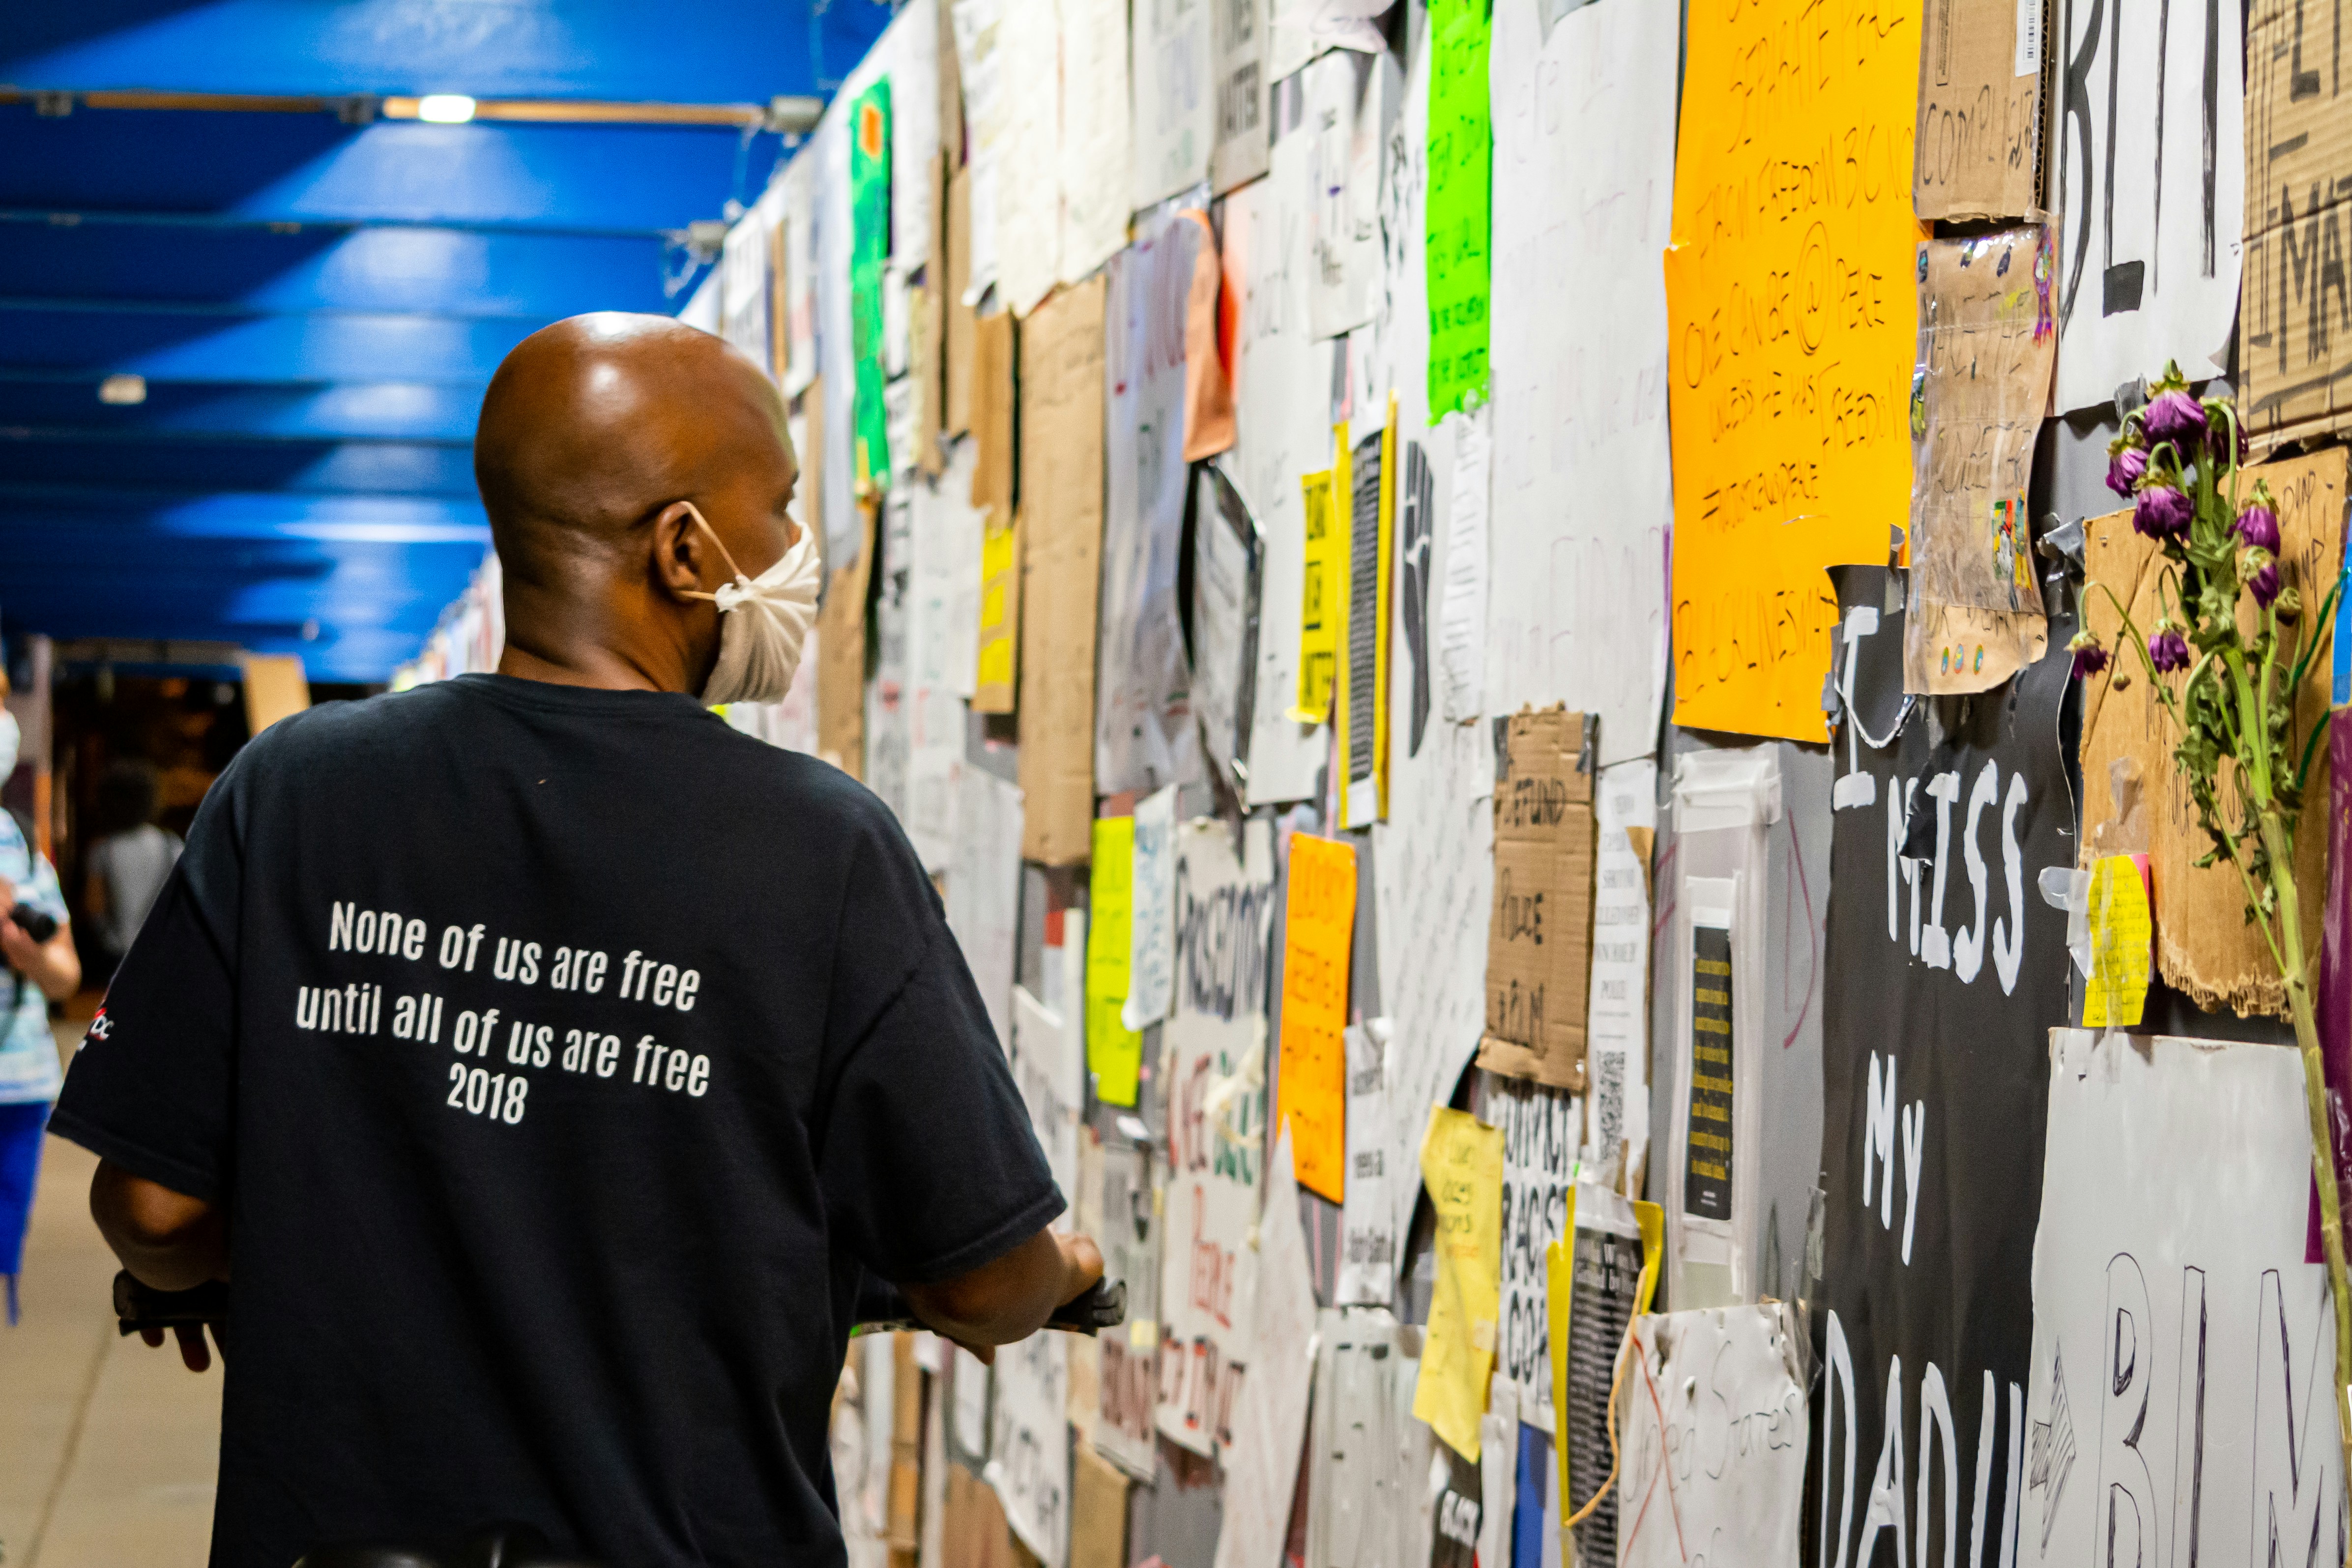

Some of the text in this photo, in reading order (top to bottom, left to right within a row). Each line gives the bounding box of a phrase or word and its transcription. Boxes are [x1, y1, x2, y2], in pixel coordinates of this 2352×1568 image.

[1767, 270, 1790, 343] BE
[1836, 258, 1886, 332] PEACE
[1887, 758, 2028, 997] MISS
[329, 900, 701, 1012] None of us are free
[296, 983, 711, 1097] until all of us are free
[447, 1062, 529, 1125] 2018
[1863, 1049, 1925, 1267] MY
